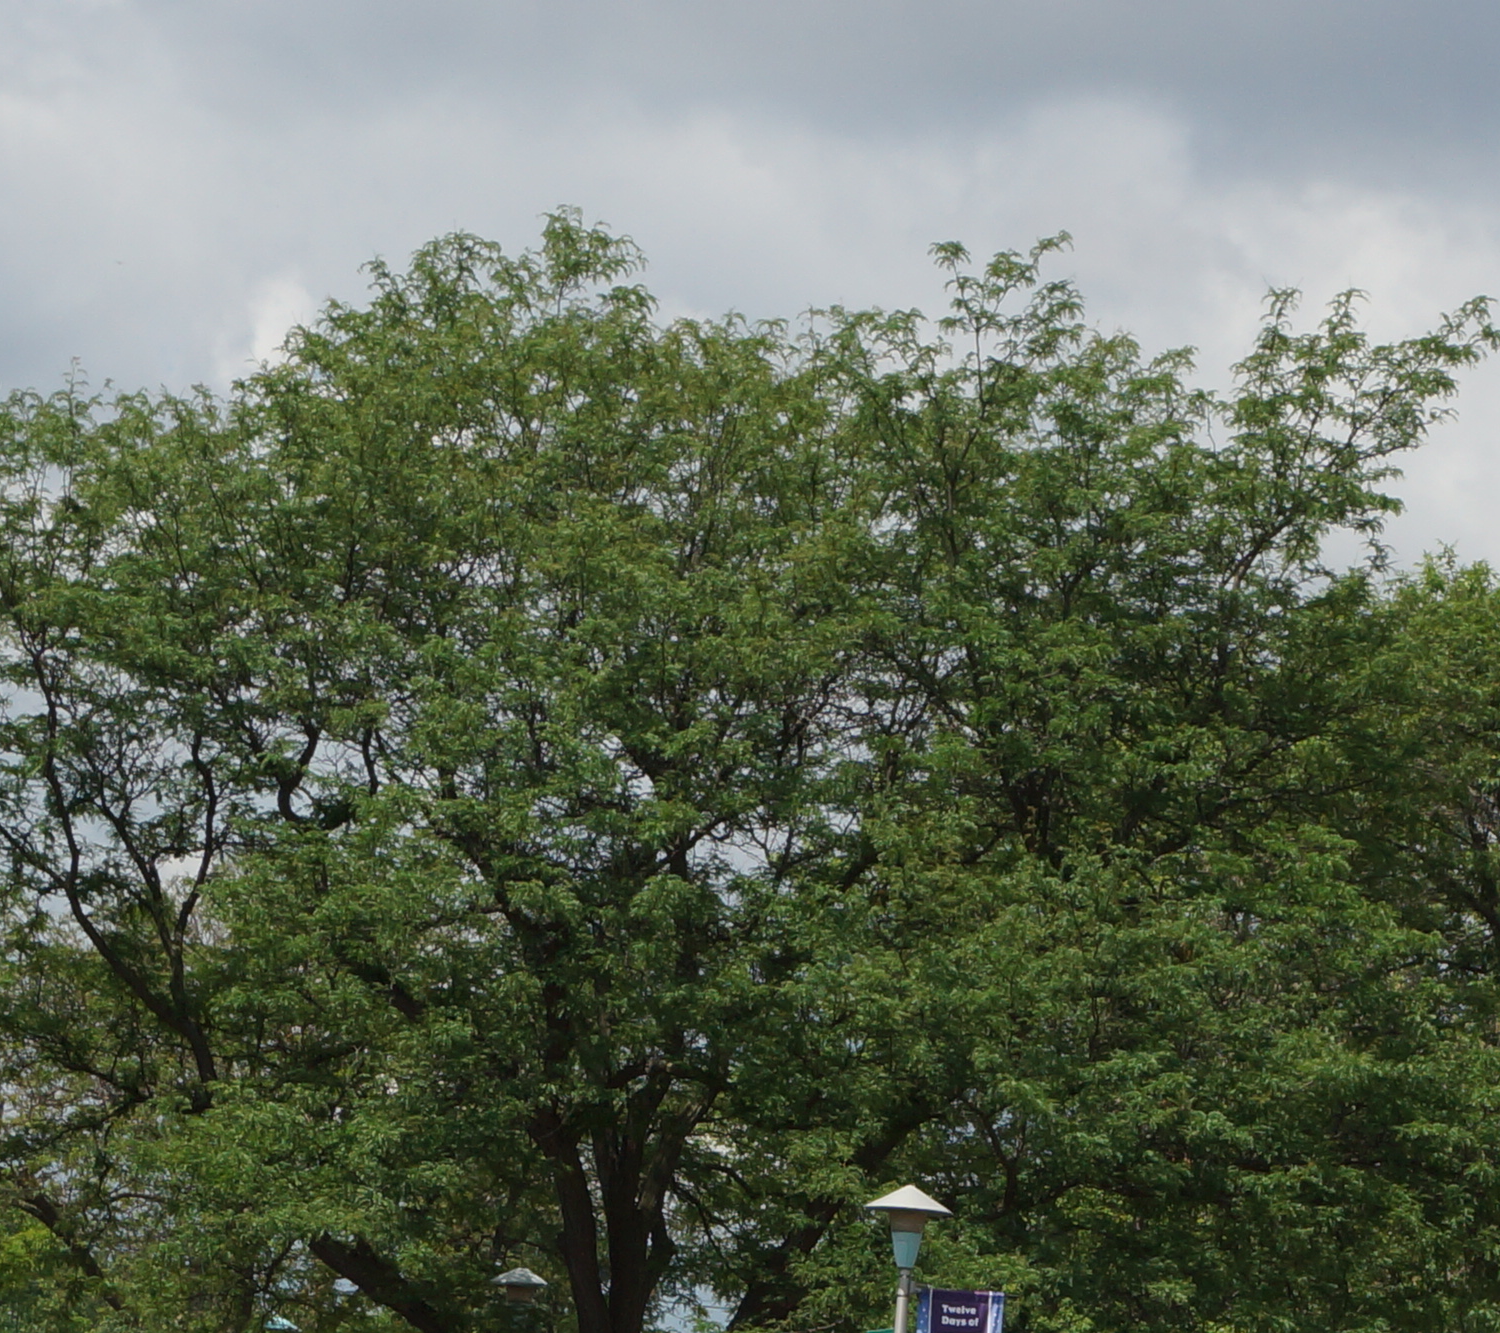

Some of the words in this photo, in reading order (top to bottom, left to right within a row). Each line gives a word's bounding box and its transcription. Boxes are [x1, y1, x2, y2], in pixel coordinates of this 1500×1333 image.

[942, 1304, 977, 1315] Twelve
[941, 1316, 968, 1327] Days
[968, 1318, 979, 1327] of
